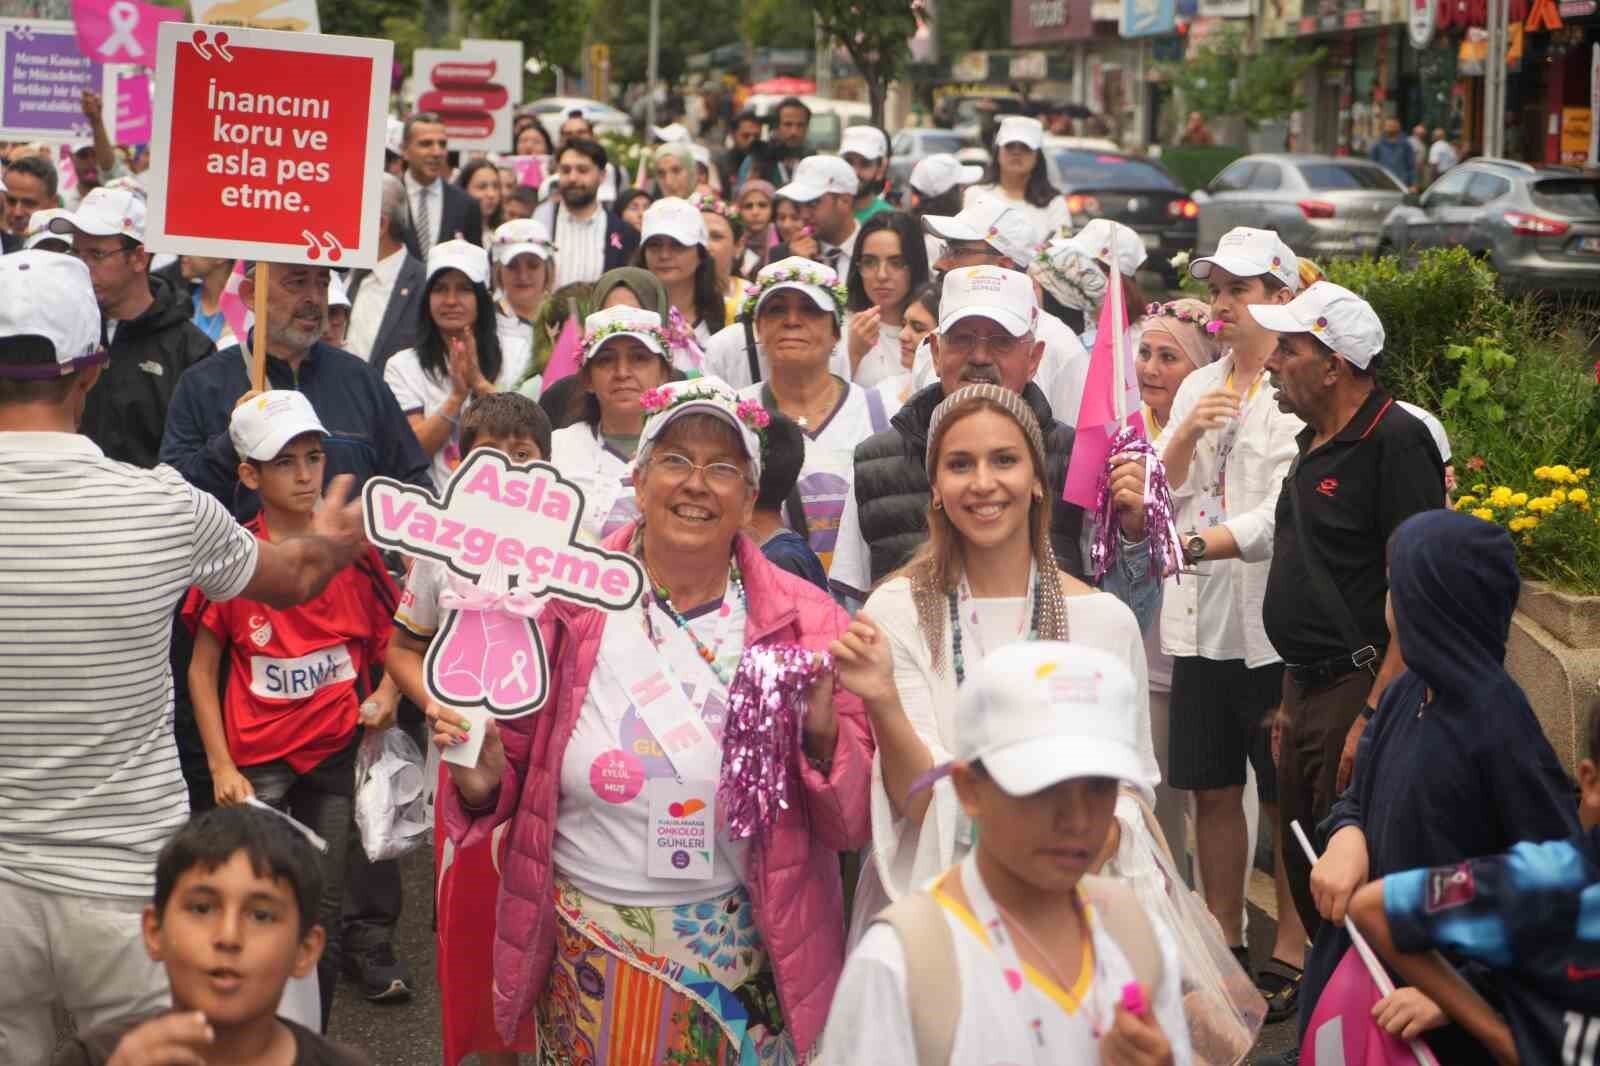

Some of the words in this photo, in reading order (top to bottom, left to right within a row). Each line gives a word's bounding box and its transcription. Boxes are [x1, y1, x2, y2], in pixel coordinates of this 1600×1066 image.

[208, 78, 329, 119] İnancını
[213, 115, 282, 147] koru
[292, 128, 328, 151] ve
[206, 148, 267, 177] asla
[277, 159, 330, 185] pes
[221, 183, 310, 212] etme.
[463, 463, 571, 522] Asla
[379, 494, 630, 597] Vazgeçme
[265, 654, 337, 693] SIRMA
